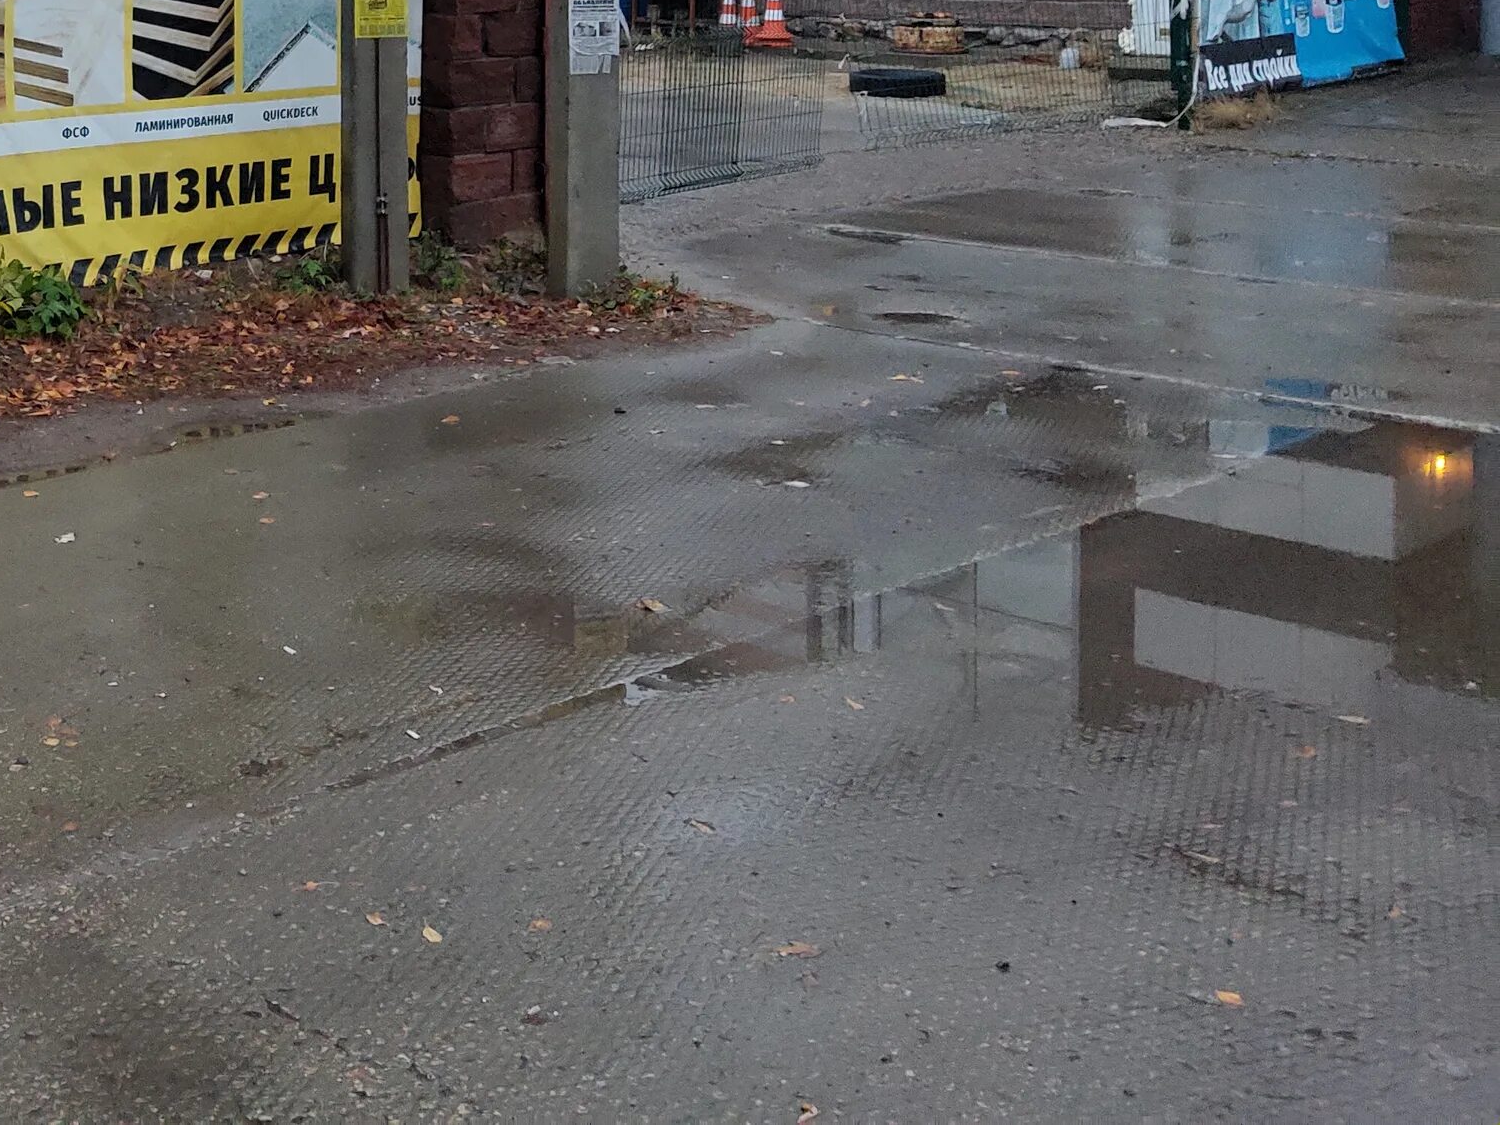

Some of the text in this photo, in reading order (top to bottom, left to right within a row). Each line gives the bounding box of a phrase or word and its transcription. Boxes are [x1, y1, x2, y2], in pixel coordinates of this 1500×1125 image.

[1204, 48, 1301, 92] Все для стройки
[134, 113, 235, 133] ЛАМИНИРОВАННАЯ
[262, 105, 319, 122] QUICKDECK
[61, 125, 90, 140] ФСФ
[103, 157, 292, 221] НИЗКИЕ
